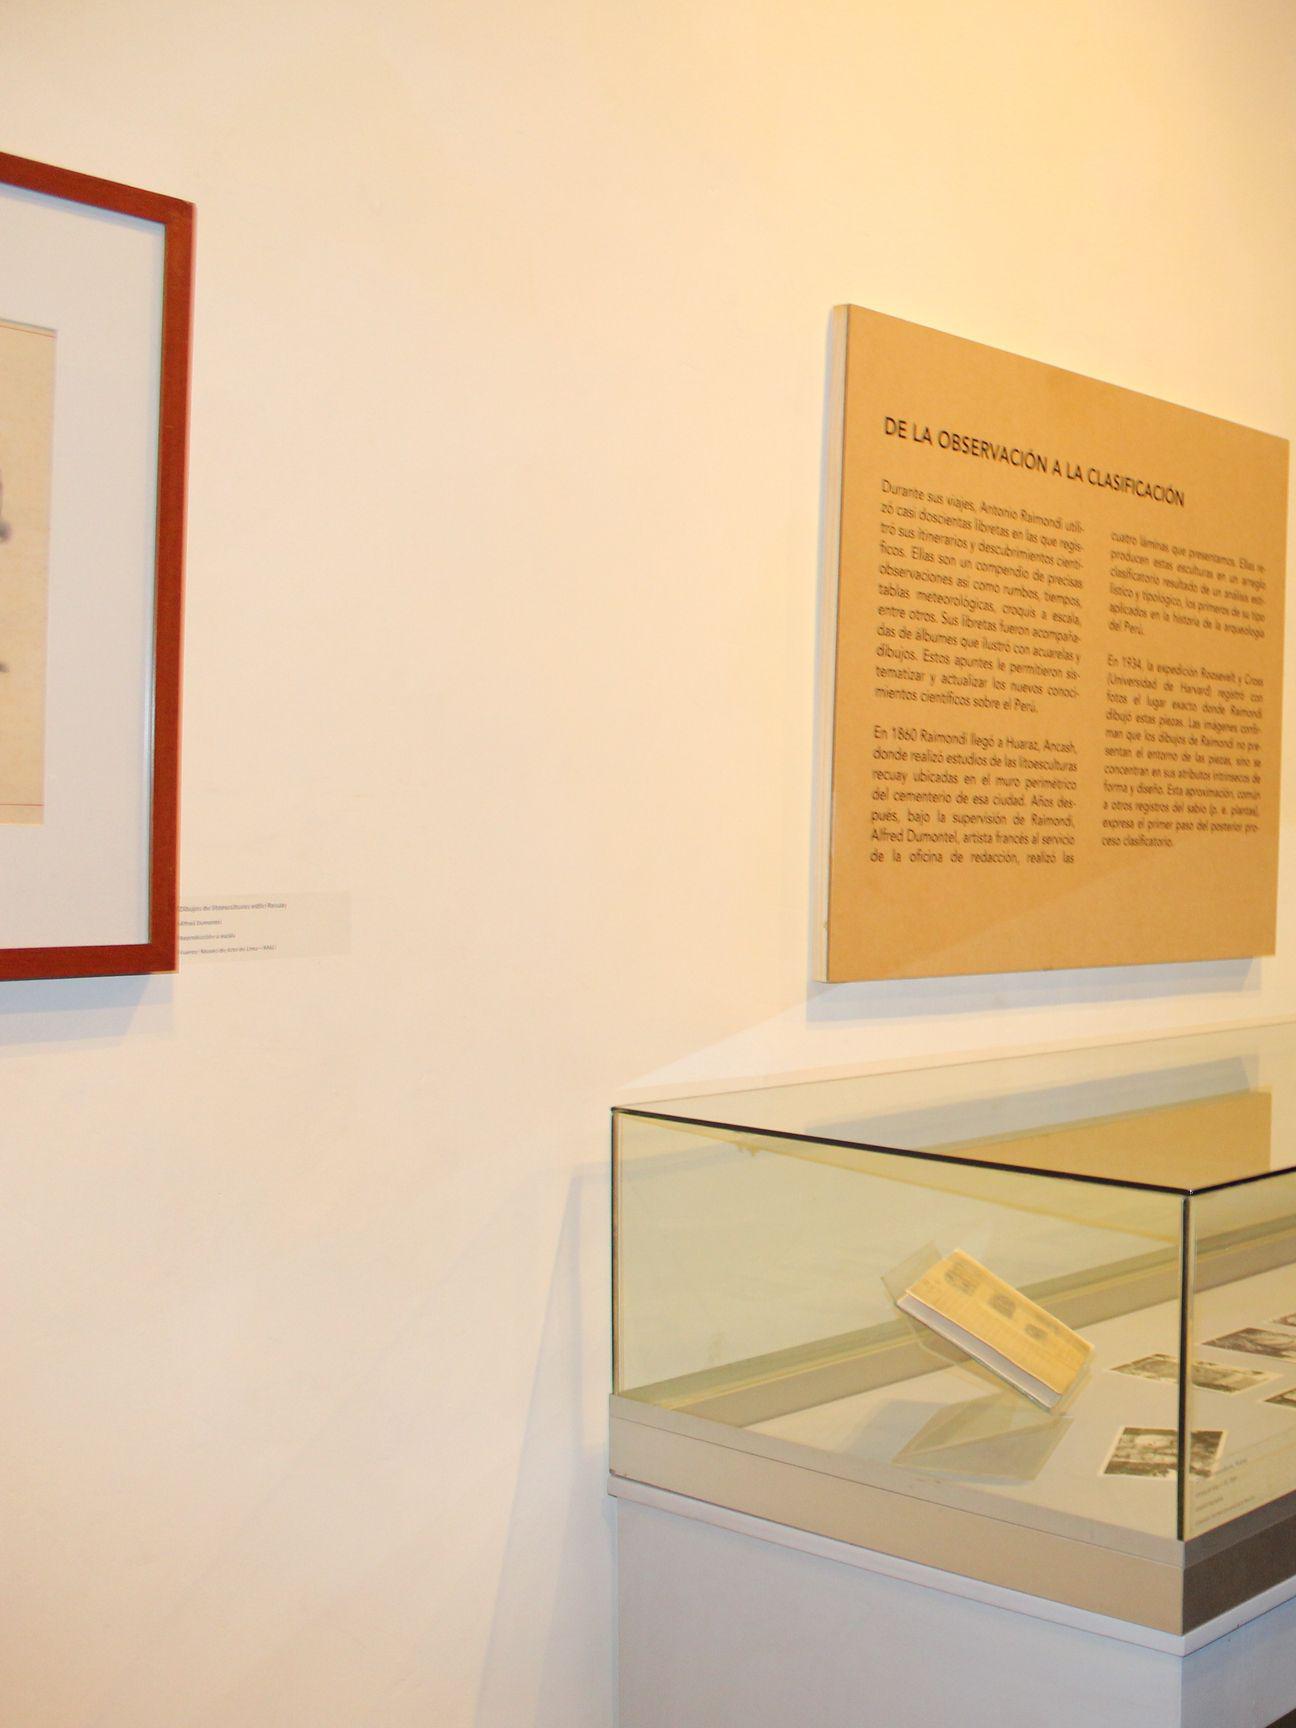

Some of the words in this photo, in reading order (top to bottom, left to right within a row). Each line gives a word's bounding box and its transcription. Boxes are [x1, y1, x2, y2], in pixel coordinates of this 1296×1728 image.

[884, 416, 908, 440] DE
[912, 424, 933, 446] LA
[937, 430, 1048, 473] OBSERVACIÓN
[1052, 458, 1062, 477] A
[1066, 462, 1084, 482] LA
[1087, 467, 1185, 506] CLASIFICACIÓN
[881, 479, 925, 501] Durante
[927, 493, 944, 505] sus
[980, 500, 1018, 520] Antonio
[1020, 509, 1063, 529] Raimondi
[896, 506, 916, 519] casi
[919, 507, 972, 530] doscientas
[975, 518, 1010, 537] libretas
[1012, 530, 1023, 540] en
[1026, 529, 1038, 543] las
[1040, 536, 1057, 548] que
[898, 527, 916, 539] sus
[917, 527, 968, 549] itinerarios
[879, 562, 953, 586] observaciones
[973, 581, 1000, 593] como
[911, 546, 935, 563] Ellas
[938, 555, 957, 566] son
[960, 559, 972, 569] un
[975, 562, 1029, 579] compendio
[1032, 568, 1045, 582] de
[1047, 574, 1083, 588] precisas
[878, 583, 910, 599] tablas
[1002, 605, 1036, 620] croquis
[878, 606, 906, 619] entre
[941, 611, 959, 626] Sus
[962, 614, 997, 631] libretas
[999, 620, 1030, 636] fueron
[876, 622, 896, 638] das
[898, 625, 913, 640] de
[960, 638, 980, 651] que
[1013, 645, 1030, 655] con
[1033, 647, 1074, 660] acuarelas
[922, 649, 950, 664] Estos
[954, 657, 993, 670] apuntes
[875, 665, 924, 681] tematizar
[941, 674, 987, 688] actualizar
[992, 677, 1006, 690] los
[1011, 683, 1043, 694] nuevos
[875, 685, 918, 701] mientos
[973, 695, 1000, 709] sobre
[873, 725, 888, 739] En
[919, 729, 968, 745] Raimondi
[872, 745, 908, 761] donde
[946, 752, 988, 765] estudios
[989, 753, 1002, 766] de
[1004, 754, 1017, 767] las
[872, 770, 907, 785] recuay
[913, 769, 959, 783] ubicadas
[963, 775, 976, 784] en
[981, 773, 991, 785] el
[995, 777, 1020, 786] muro
[871, 787, 890, 800] del
[893, 790, 952, 803] cementerio
[955, 791, 969, 803] de
[972, 795, 990, 804] esa
[1031, 794, 1054, 807] Años
[907, 809, 931, 826] bajo
[937, 810, 947, 822] la
[1013, 812, 1025, 825] de
[870, 828, 905, 841] Alfred
[963, 830, 993, 843] artista
[1041, 832, 1076, 844] servicio
[870, 849, 885, 862] de
[892, 849, 902, 862] la
[909, 849, 943, 862] oficina
[950, 850, 964, 862] de
[1062, 851, 1075, 863] las
